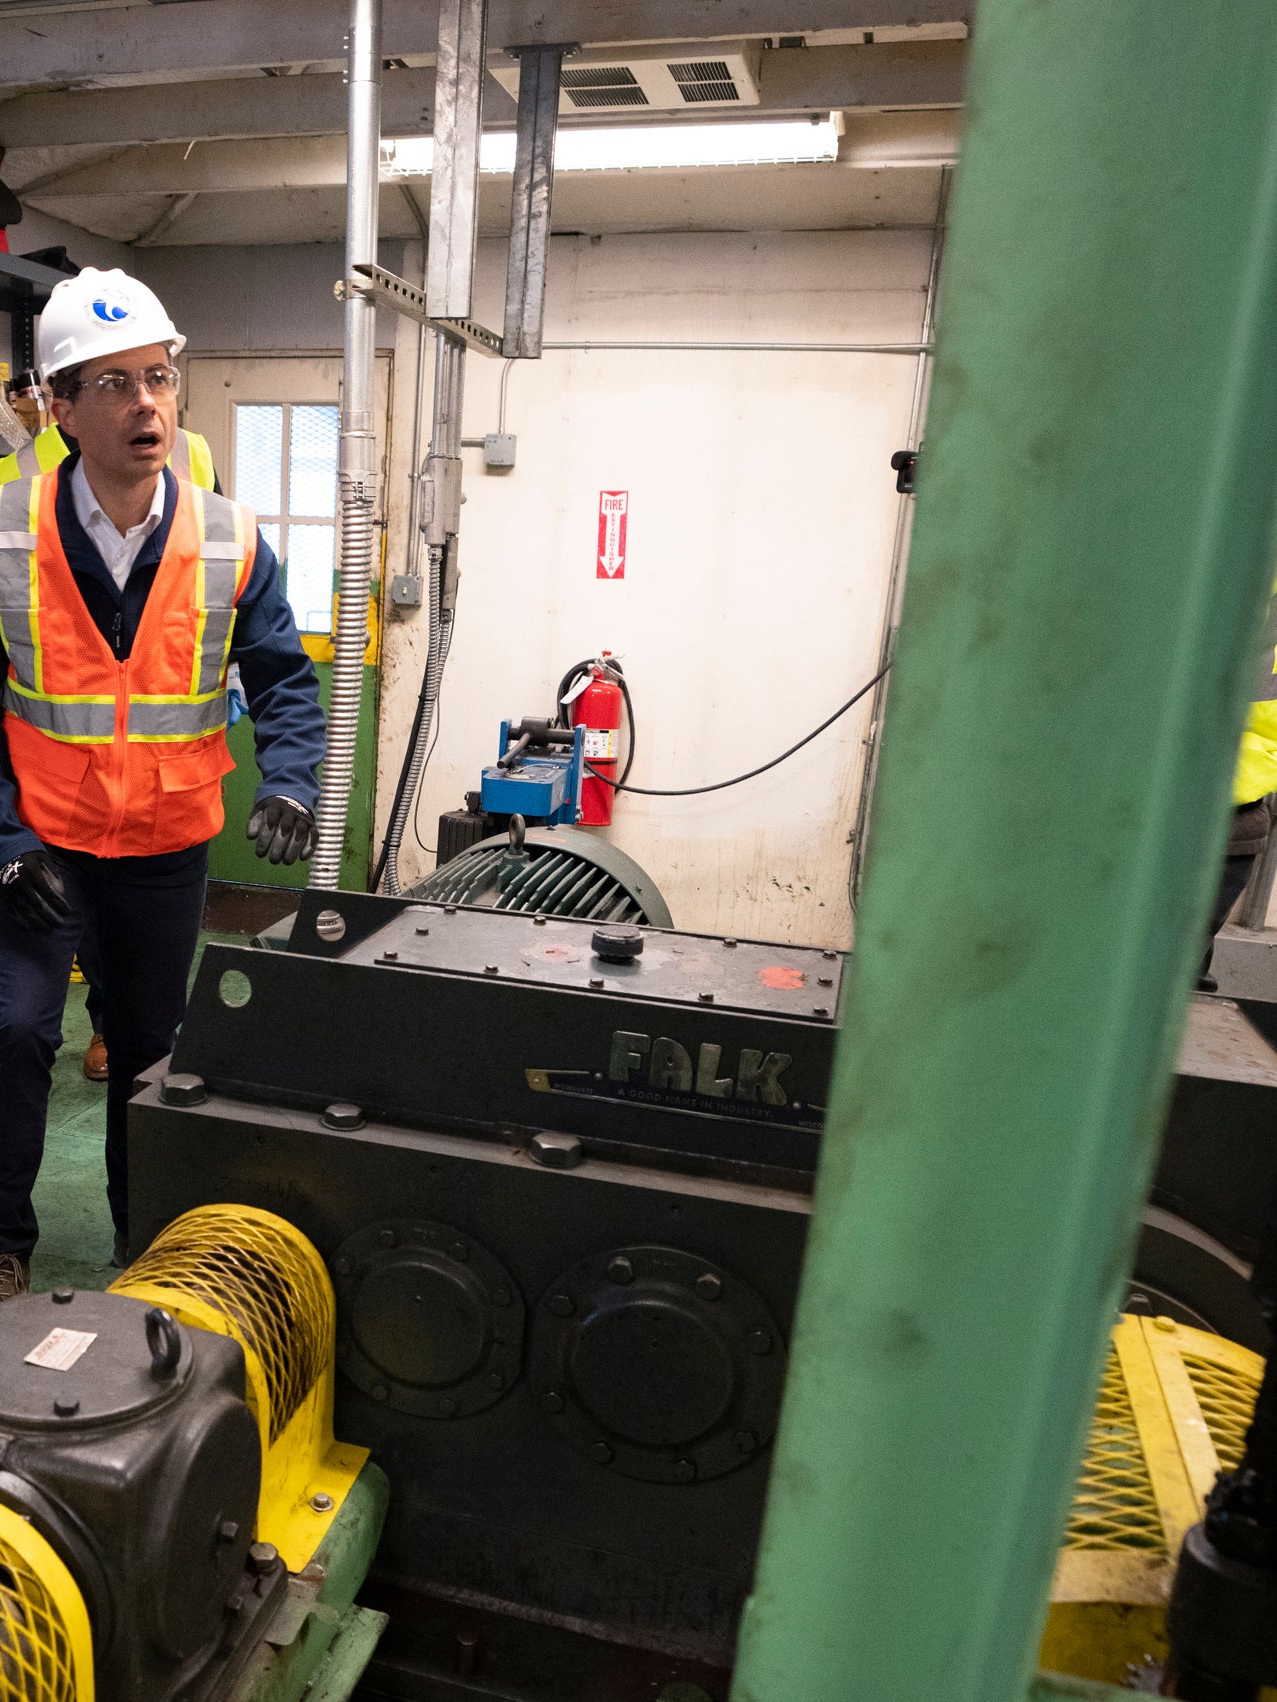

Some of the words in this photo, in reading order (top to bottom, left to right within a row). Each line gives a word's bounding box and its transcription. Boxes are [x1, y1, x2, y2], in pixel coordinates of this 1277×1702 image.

[604, 499, 624, 511] FIRE
[609, 1030, 793, 1106] FALK
[617, 1087, 625, 1096] A
[629, 1089, 661, 1102] GOOD
[665, 1095, 697, 1107] NAME
[700, 1100, 712, 1109] IN
[798, 1119, 825, 1129] WISCO
